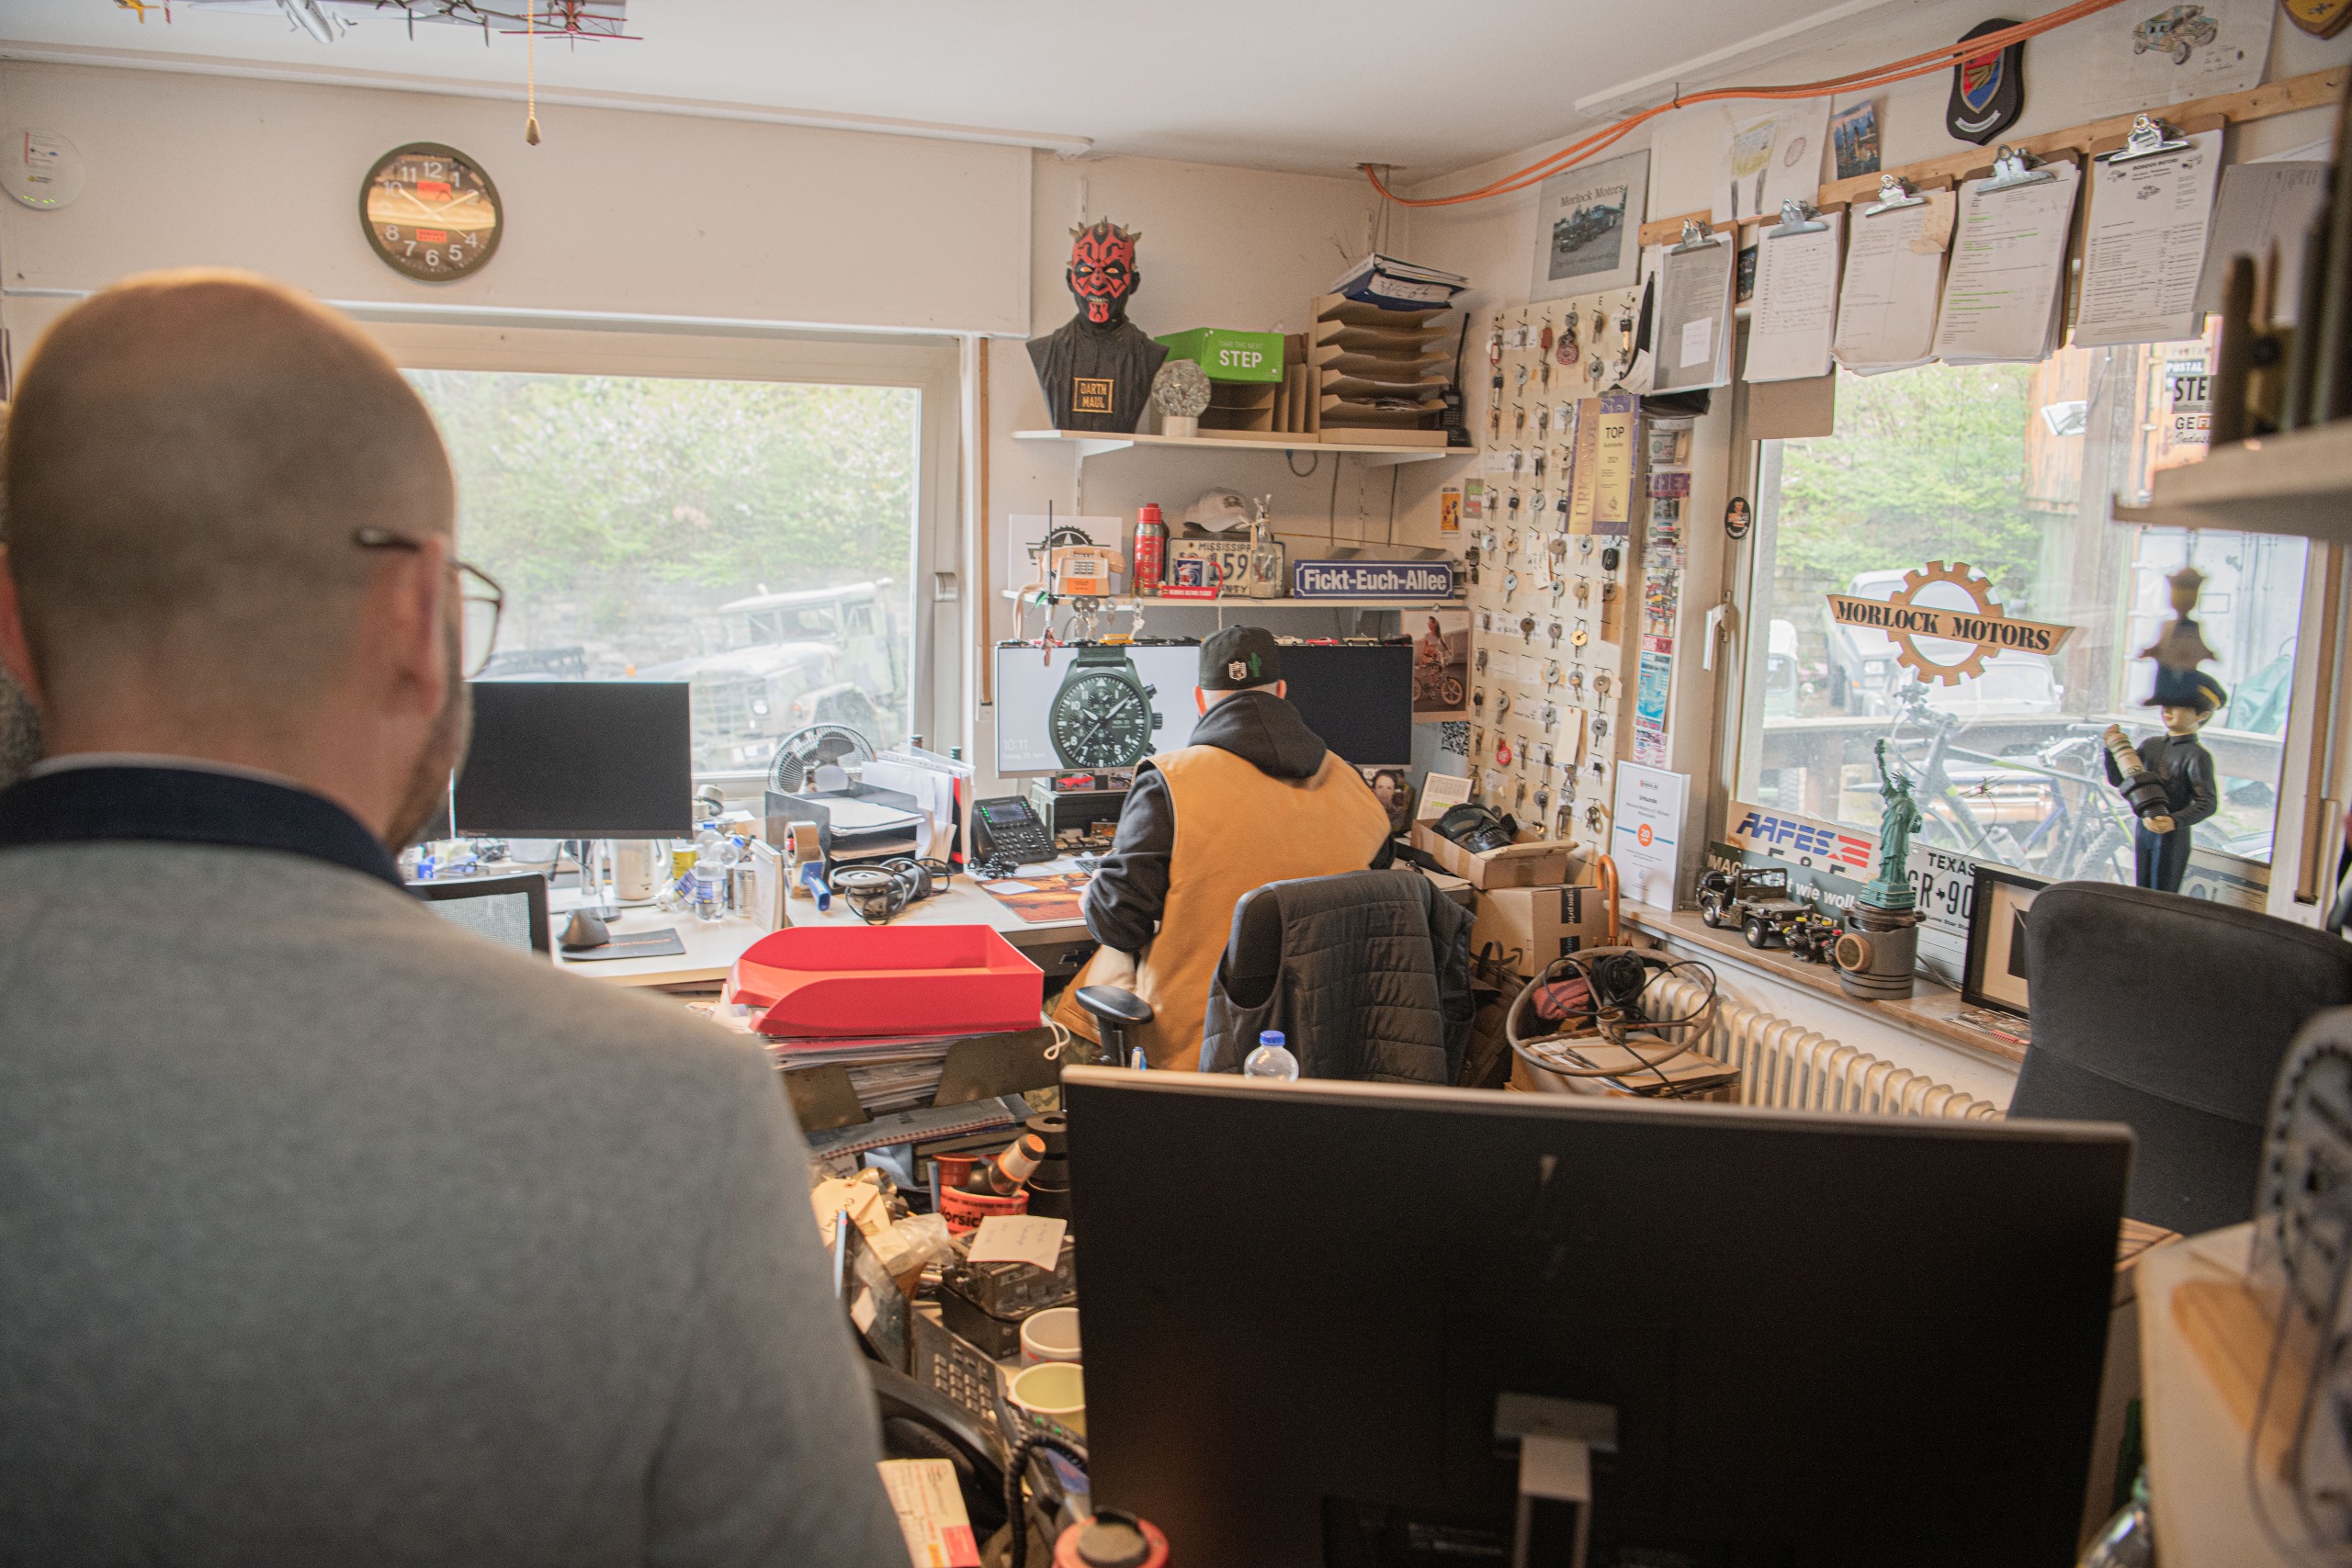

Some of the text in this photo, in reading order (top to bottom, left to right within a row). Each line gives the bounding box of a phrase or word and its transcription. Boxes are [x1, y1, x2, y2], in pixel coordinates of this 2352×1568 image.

[401, 166, 417, 183] 11
[424, 162, 442, 178] 12
[453, 172, 460, 187] 1
[384, 180, 402, 198] 10
[1560, 184, 1623, 208] Morlock Motors
[385, 223, 400, 241] 8
[465, 232, 478, 247] 4
[403, 240, 416, 256] 7
[448, 244, 462, 261] 5
[425, 249, 439, 266] 6
[1219, 349, 1263, 368] STEP
[2167, 361, 2203, 374] POSTAL
[1080, 382, 1107, 396] DARTH
[2174, 377, 2211, 402] STE
[1081, 396, 1105, 408] MAUL
[1605, 426, 1624, 439] TOP
[1575, 421, 1597, 515] URKUNDE
[1198, 542, 1253, 552] MISSISSIPP
[1304, 569, 1447, 591] Fickt-Euch-Allee
[1836, 600, 2052, 651] MORLOCK MOTORS
[1070, 701, 1080, 710] 10
[1002, 739, 1028, 751] 10:11
[1114, 744, 1122, 755] 5
[1736, 811, 1836, 856] AAFES
[1928, 852, 1976, 877] TEXAS
[1795, 880, 1821, 901] wie
[1823, 890, 1856, 908] woll
